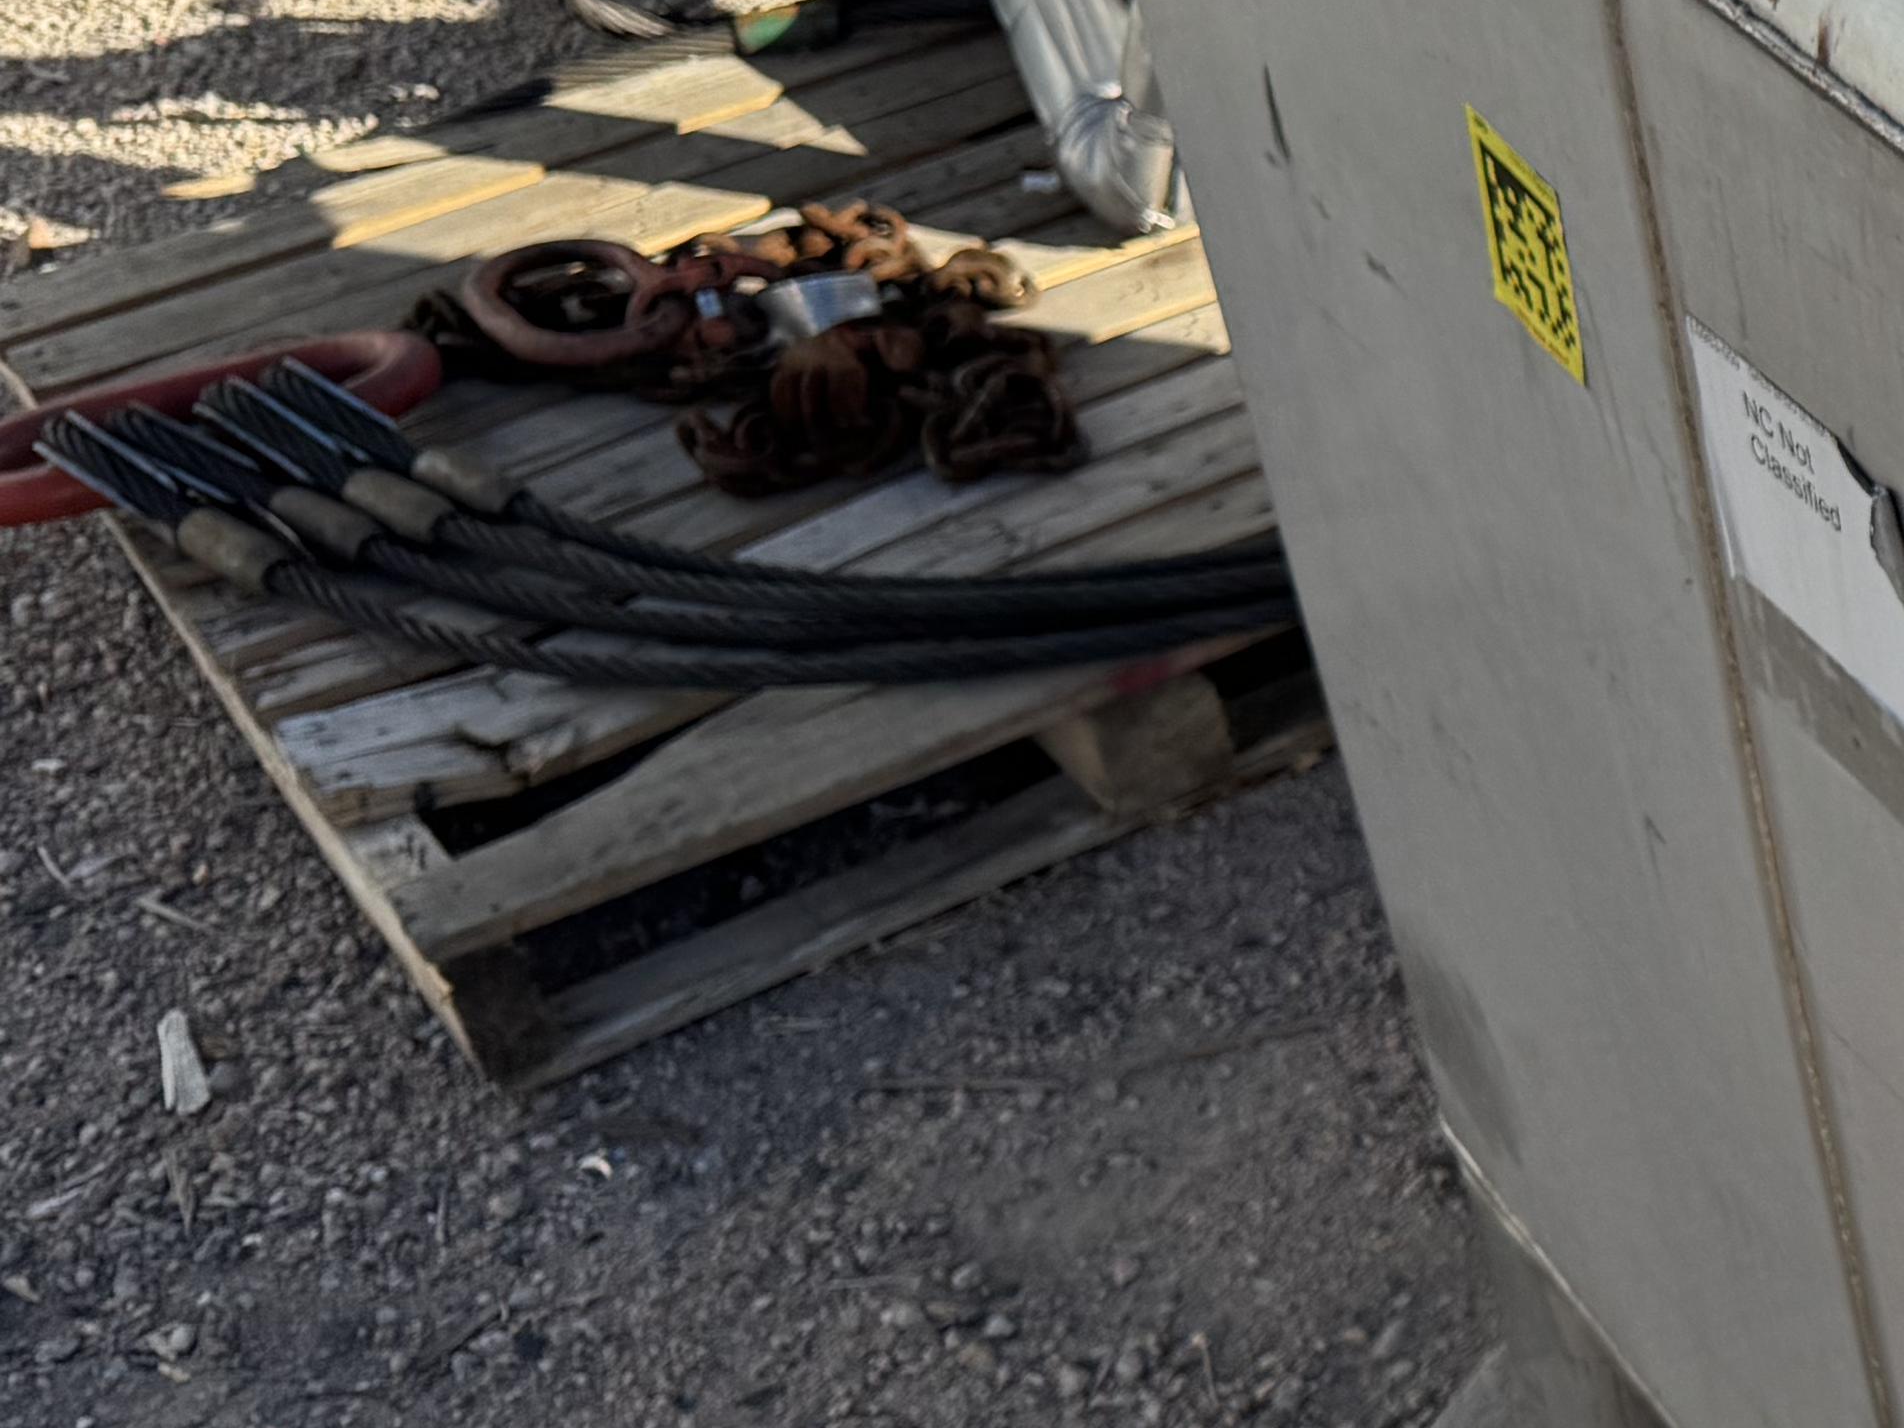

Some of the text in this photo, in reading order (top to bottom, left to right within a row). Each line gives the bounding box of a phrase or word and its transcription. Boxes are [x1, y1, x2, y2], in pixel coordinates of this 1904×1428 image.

[1743, 390, 1816, 476] NC Not
[1750, 433, 1843, 534] Classified
